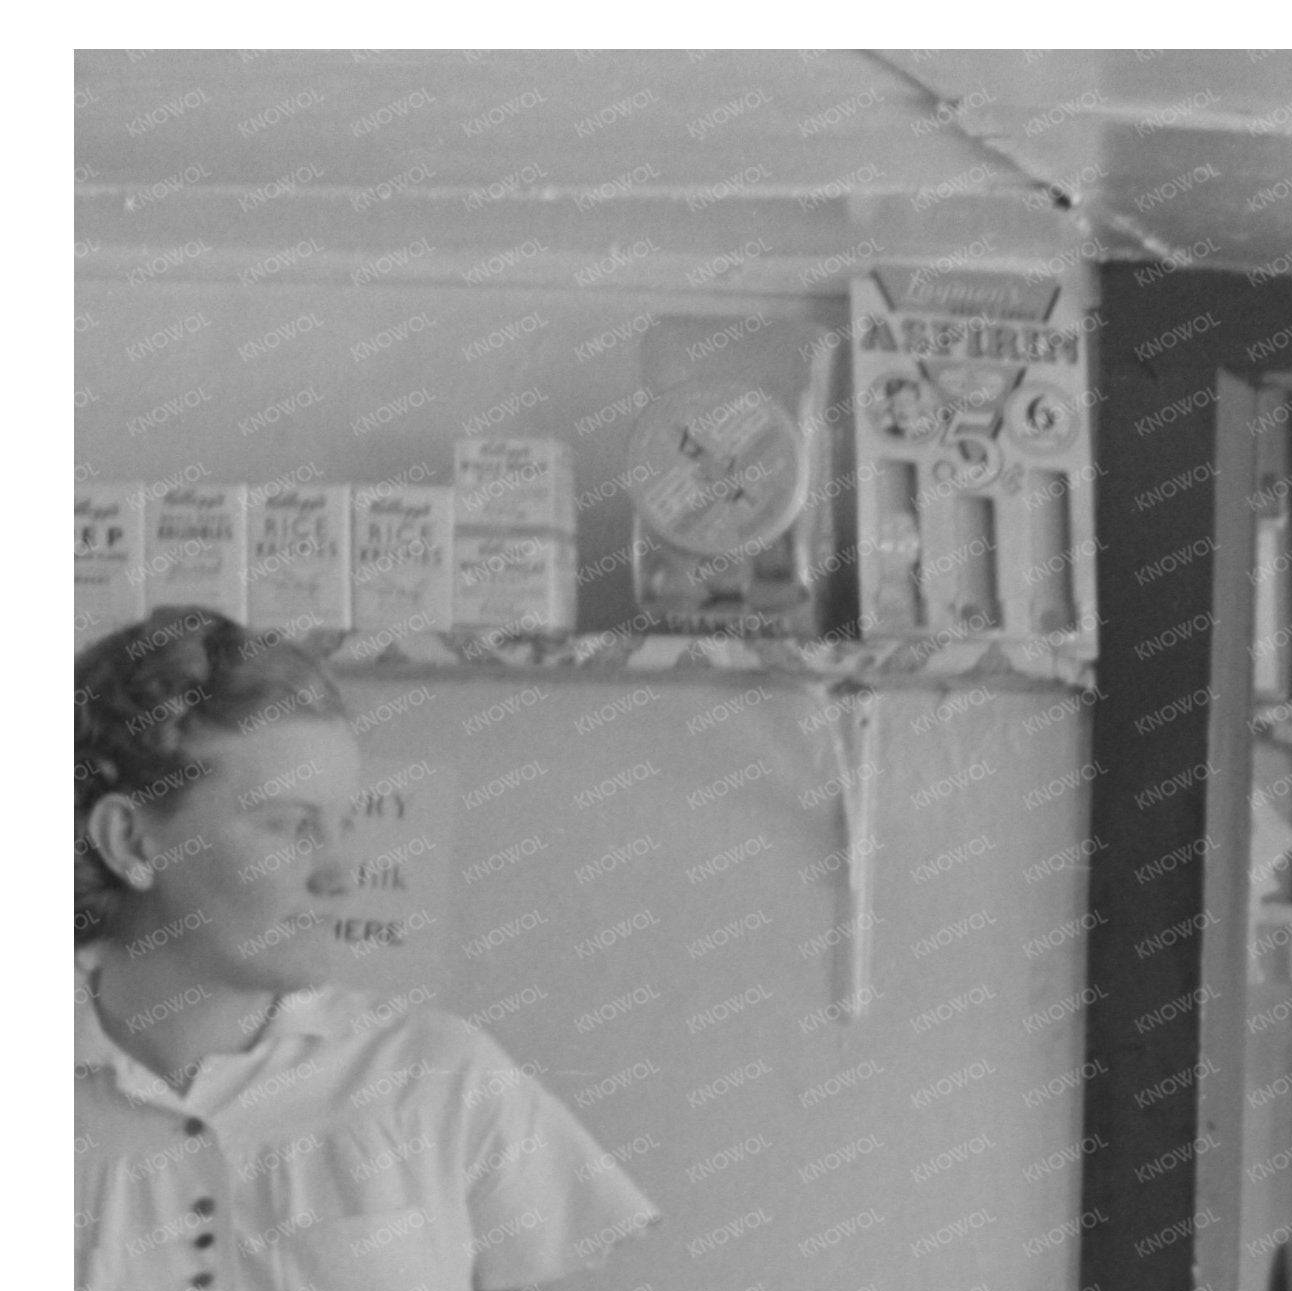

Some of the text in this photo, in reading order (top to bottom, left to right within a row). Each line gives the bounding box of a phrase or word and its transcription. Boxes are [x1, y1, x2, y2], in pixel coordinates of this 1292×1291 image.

[861, 316, 1079, 365] ASPIRIN
[79, 526, 124, 547] EP
[264, 516, 326, 539] RICE
[369, 522, 431, 544] RICE
